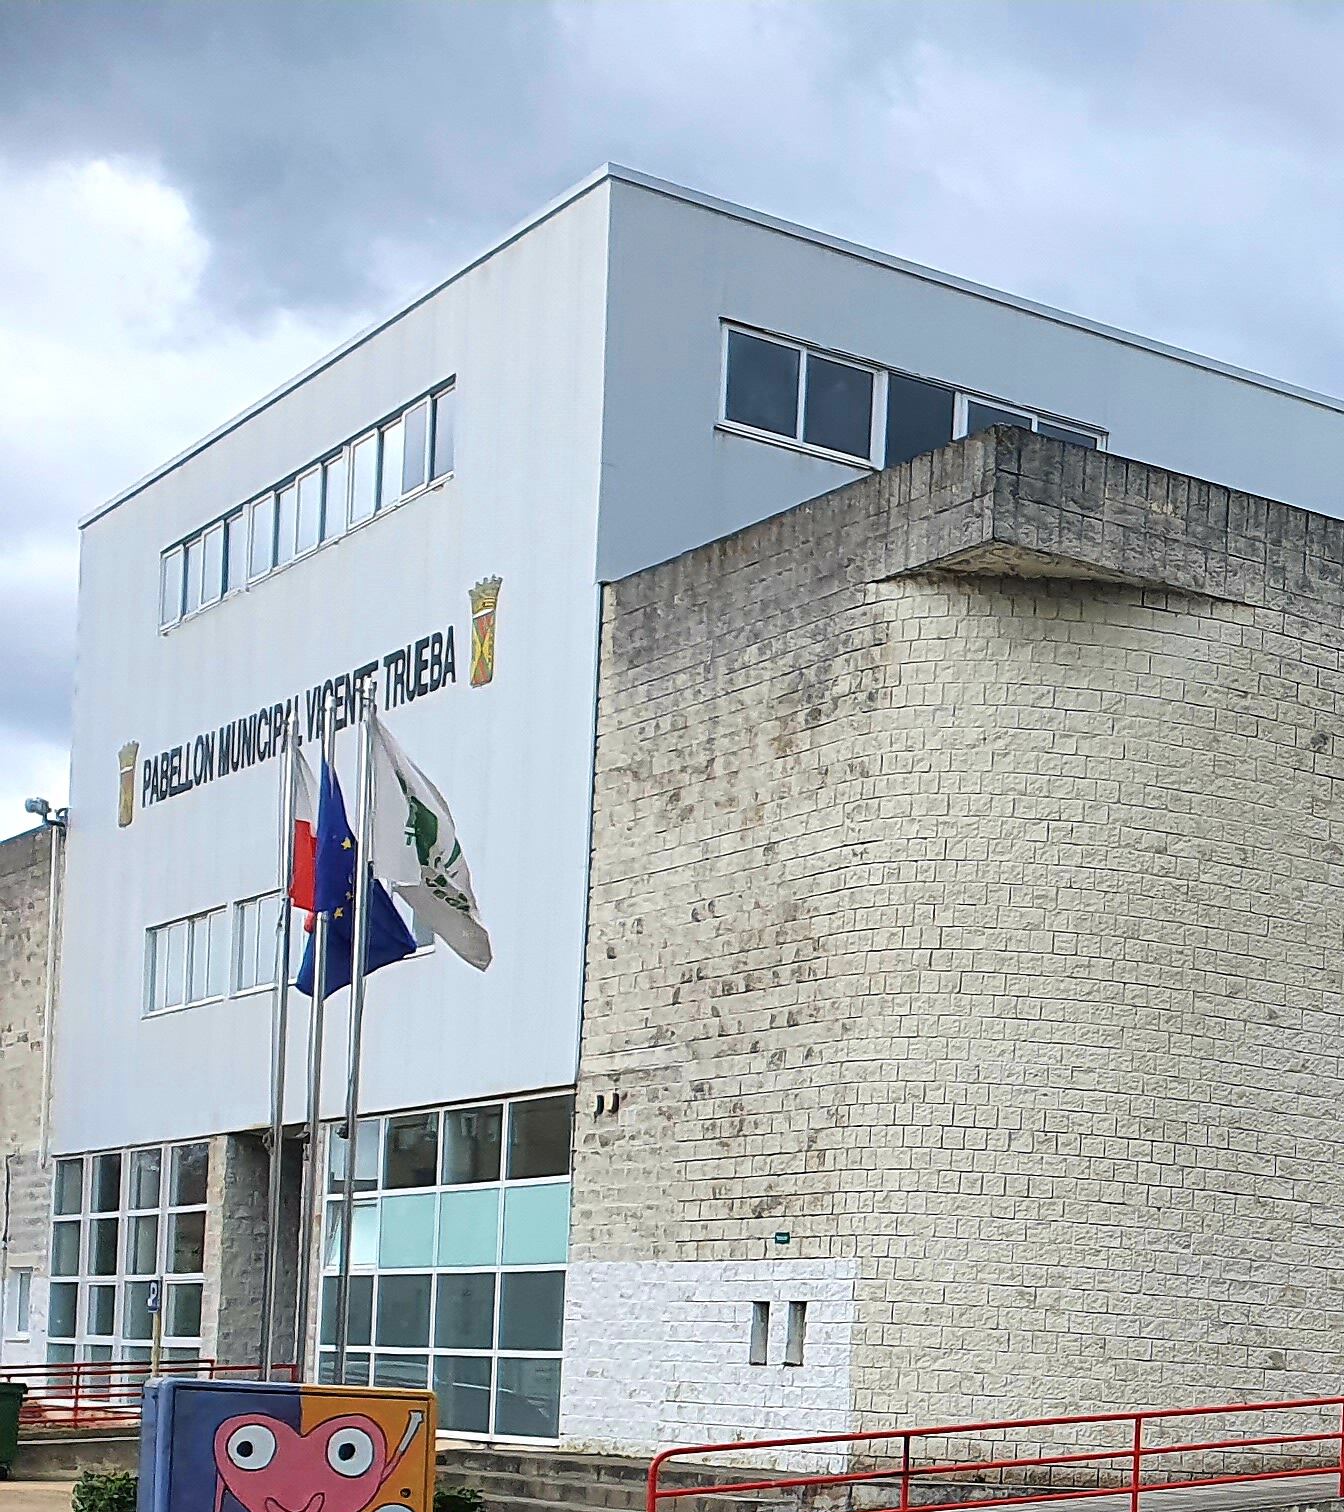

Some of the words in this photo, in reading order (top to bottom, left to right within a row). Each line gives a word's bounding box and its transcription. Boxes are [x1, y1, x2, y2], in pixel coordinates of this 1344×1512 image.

[142, 731, 216, 809] PABELLON
[218, 695, 303, 778] MUNICIPAL
[383, 625, 456, 711] TRUEBA
